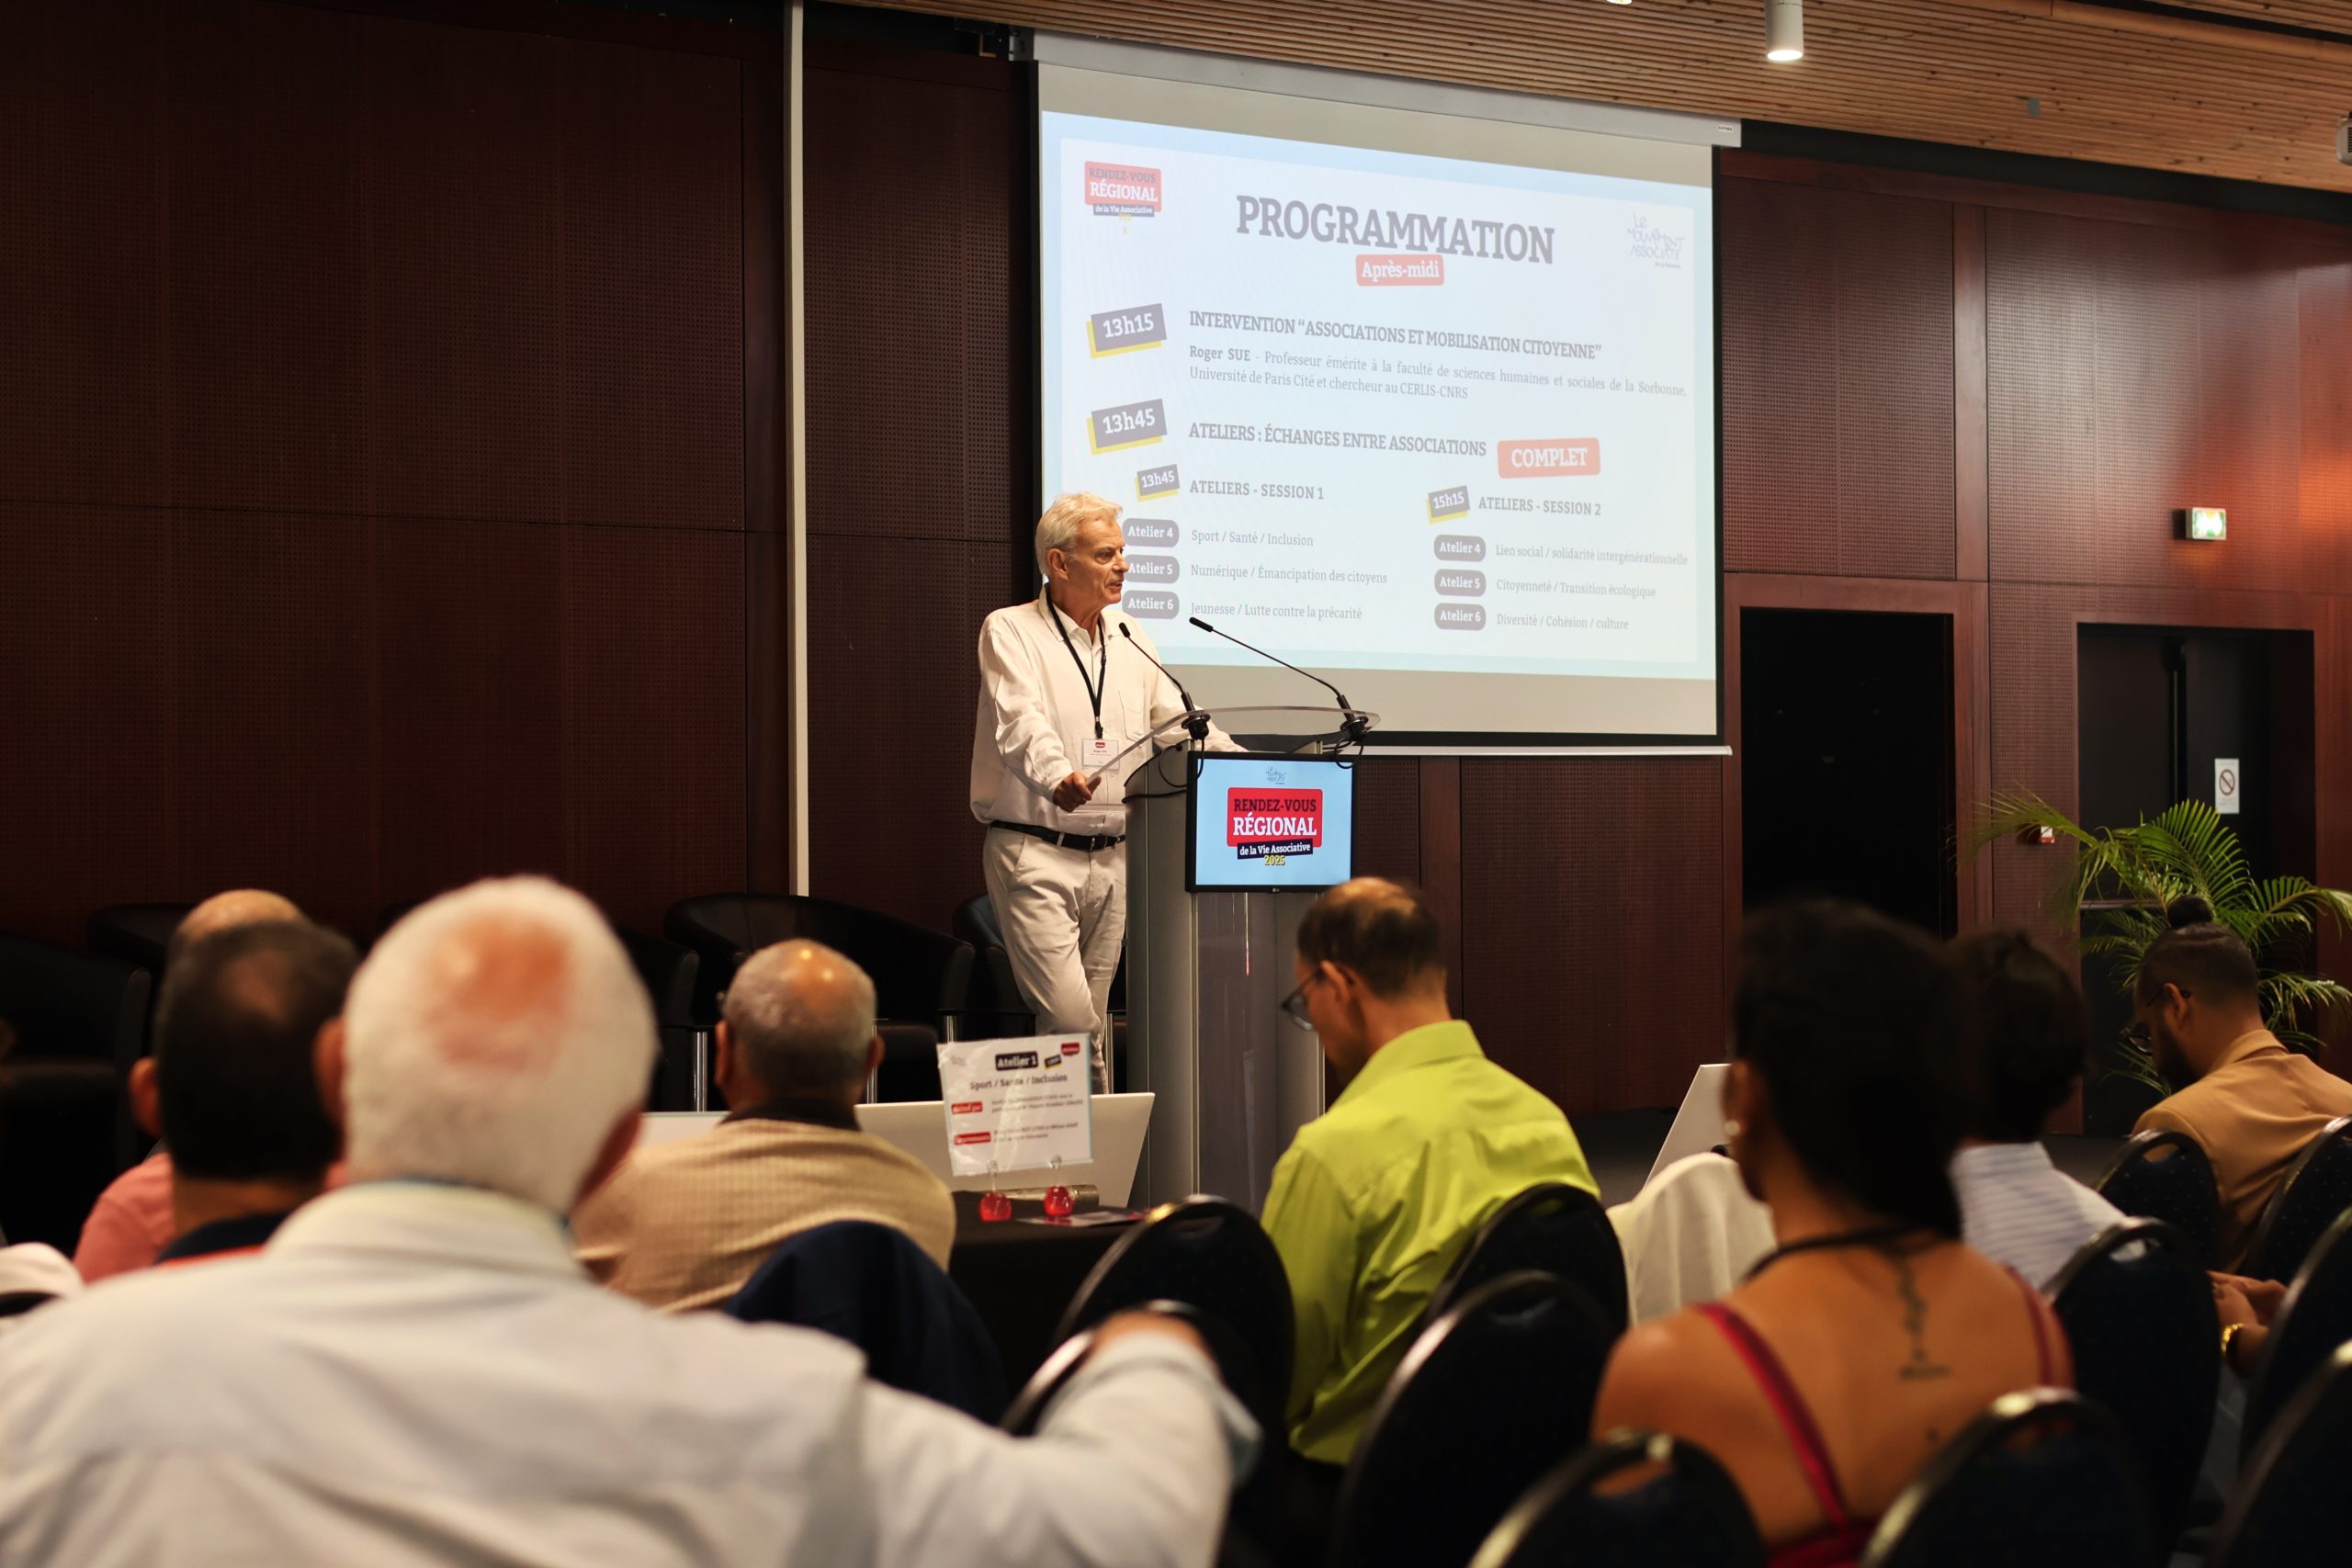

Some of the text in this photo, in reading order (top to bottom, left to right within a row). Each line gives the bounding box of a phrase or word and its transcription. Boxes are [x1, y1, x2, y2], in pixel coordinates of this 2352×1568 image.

[1089, 167, 1156, 183] RENDEZ-VOUS
[1090, 179, 1159, 202] RÉGIONAL
[1104, 205, 1110, 213] la
[1120, 206, 1153, 214] Associative
[1237, 195, 1555, 264] PROGRAMMATION
[1362, 261, 1440, 282] Après-midi
[1103, 313, 1154, 338] 13h15
[1190, 310, 1295, 334] INTERVENTION
[1408, 329, 1423, 345] ET
[1426, 331, 1520, 353] MOBILISATION
[1522, 339, 1601, 360] CITOYENNE”
[1190, 345, 1223, 362] Roger
[1228, 349, 1250, 362] SUE
[1264, 351, 1322, 367] Professeur
[1326, 355, 1367, 371] émérite
[1372, 358, 1378, 371] à
[1383, 359, 1392, 373] la
[1396, 360, 1433, 377] faculté
[1437, 365, 1450, 378] de
[1453, 367, 1496, 381] sciences
[1500, 369, 1549, 386] humaines
[1554, 376, 1564, 387] et
[1567, 376, 1606, 390] sociales
[1610, 378, 1622, 391] de
[1625, 379, 1634, 392] la
[1190, 367, 1468, 400] Université de Paris Cité et chercheur au CERLIS-CNRS
[1102, 409, 1155, 434] 13h45
[1189, 423, 1255, 442] ATELIERS
[1264, 424, 1340, 446] ÉCHANGES
[1342, 431, 1386, 450] ENTRE
[1388, 434, 1487, 457] ASSOCIATIONS
[1511, 447, 1588, 467] COMPLET
[1141, 471, 1175, 488] 13h45
[1190, 480, 1250, 496] ATELIERS
[1261, 484, 1314, 499] SESSION
[1317, 487, 1324, 500] 1
[1433, 491, 1464, 509] 15h15
[1479, 496, 1533, 512] ATELIERS
[1544, 500, 1592, 515] SESSION
[1594, 503, 1601, 515] 2
[1128, 525, 1173, 538] Atelier 4
[1192, 530, 1219, 542] Sport
[1229, 532, 1259, 545] Santé
[1267, 532, 1314, 547] Inclusion
[1440, 541, 1481, 554] Atelier 4
[1496, 545, 1516, 557] Lien
[1517, 547, 1544, 558] social
[1552, 548, 1595, 561] solidarité
[1597, 551, 1689, 566] intergénérationnelle
[1129, 562, 1173, 575] Atelier 5
[1191, 564, 1249, 579] Numérique
[1258, 565, 1327, 583] Émancipation
[1329, 569, 1346, 582] des
[1347, 570, 1387, 585] citoyens
[1440, 576, 1480, 589] Atelier 5
[1497, 580, 1552, 593] Citoyenneté
[1560, 582, 1607, 595] Transition
[1608, 584, 1657, 600] écologique
[1128, 598, 1173, 611] Atelier 6
[1191, 602, 1236, 615] Jeunesse
[1244, 604, 1272, 616] Lutte
[1272, 605, 1306, 618] contre
[1307, 605, 1317, 618] la
[1317, 606, 1363, 621] précarité
[1440, 610, 1481, 622] Atelier 6
[1497, 614, 1538, 626] Diversité
[1546, 615, 1588, 628] Cohésion
[1596, 618, 1629, 630] culture
[1234, 798, 1317, 812] RENDEZ-VOUS
[1233, 811, 1317, 836] RÉGIONAL
[1239, 842, 1311, 856] de la Vie Associative
[1264, 855, 1285, 866] 2025
[997, 1055, 1030, 1068] Atelier
[970, 1081, 992, 1091] Sport
[1032, 1074, 1068, 1085] Inclusion
